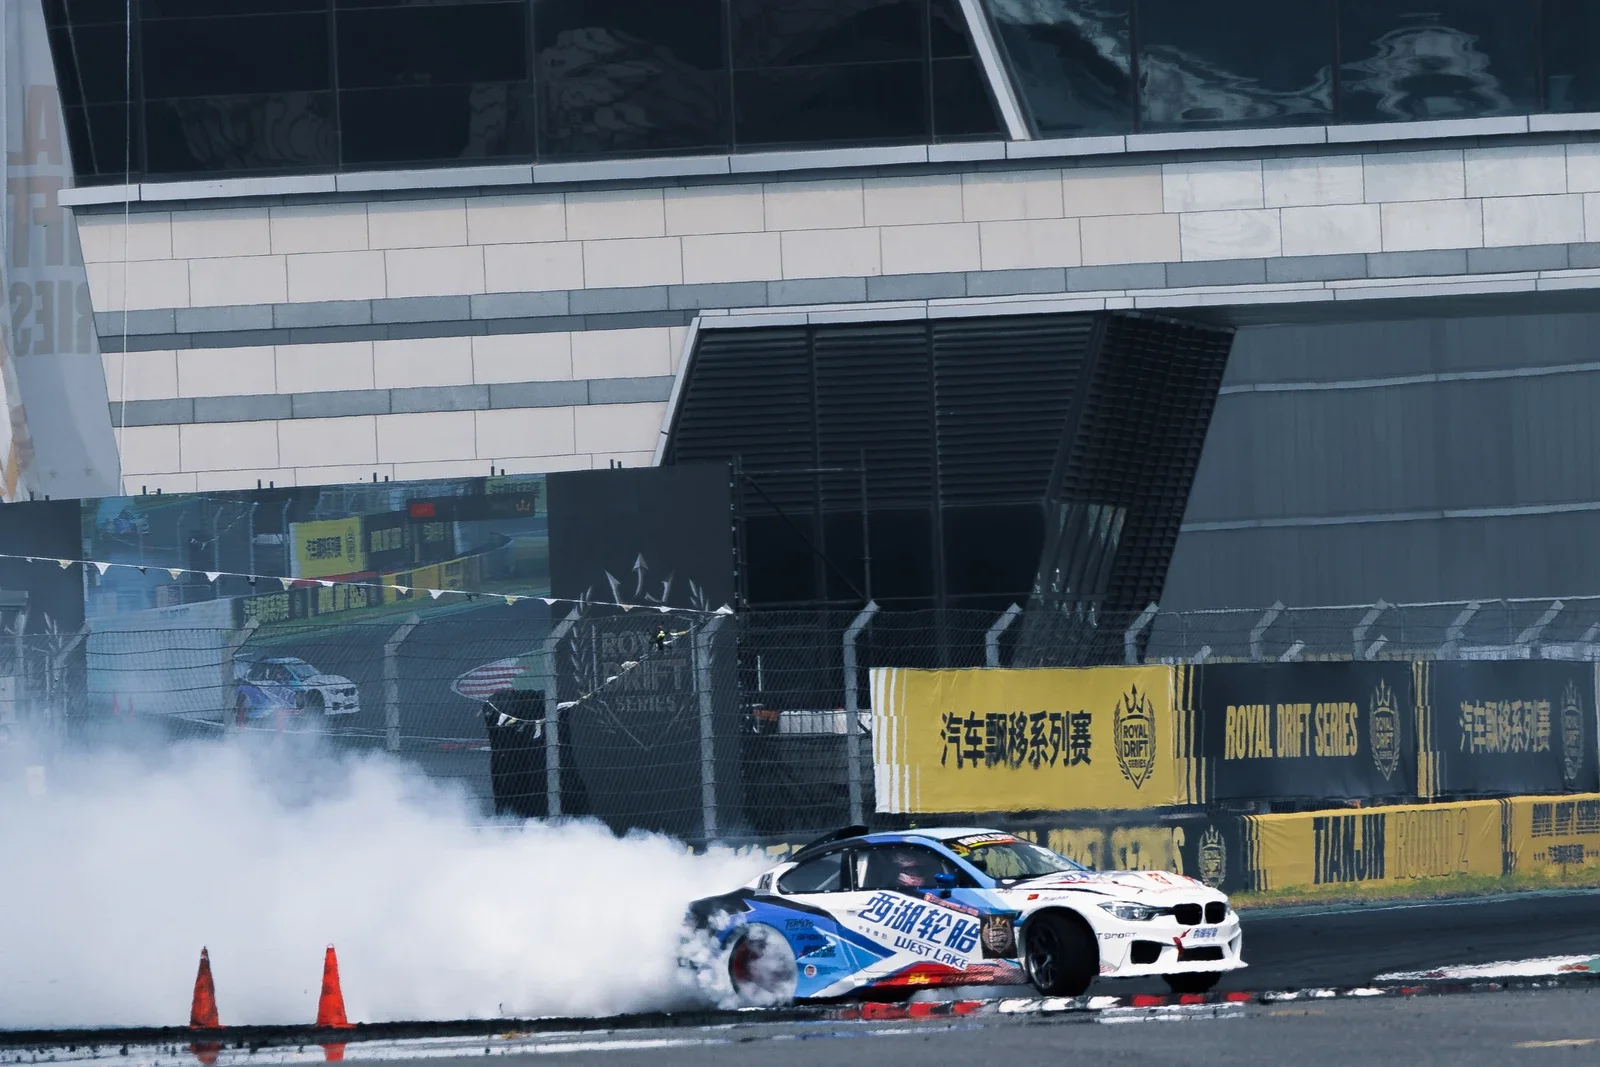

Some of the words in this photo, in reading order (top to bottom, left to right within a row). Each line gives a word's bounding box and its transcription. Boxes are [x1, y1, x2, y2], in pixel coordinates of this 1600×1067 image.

[940, 709, 1092, 770] 汽车飘移系列赛
[1123, 724, 1148, 739] ROYAL
[1123, 740, 1148, 758] DRIFT
[1224, 704, 1273, 760] ROYAL
[1276, 703, 1311, 758] DRIFT
[1314, 702, 1358, 757] SERIES
[1128, 759, 1146, 768] SERIES
[1313, 813, 1386, 884] TIANJIN
[1394, 808, 1451, 879] ROUND
[857, 892, 980, 953] 西湖轮胎
[894, 936, 932, 957] WEST
[933, 948, 969, 970] LAKE
